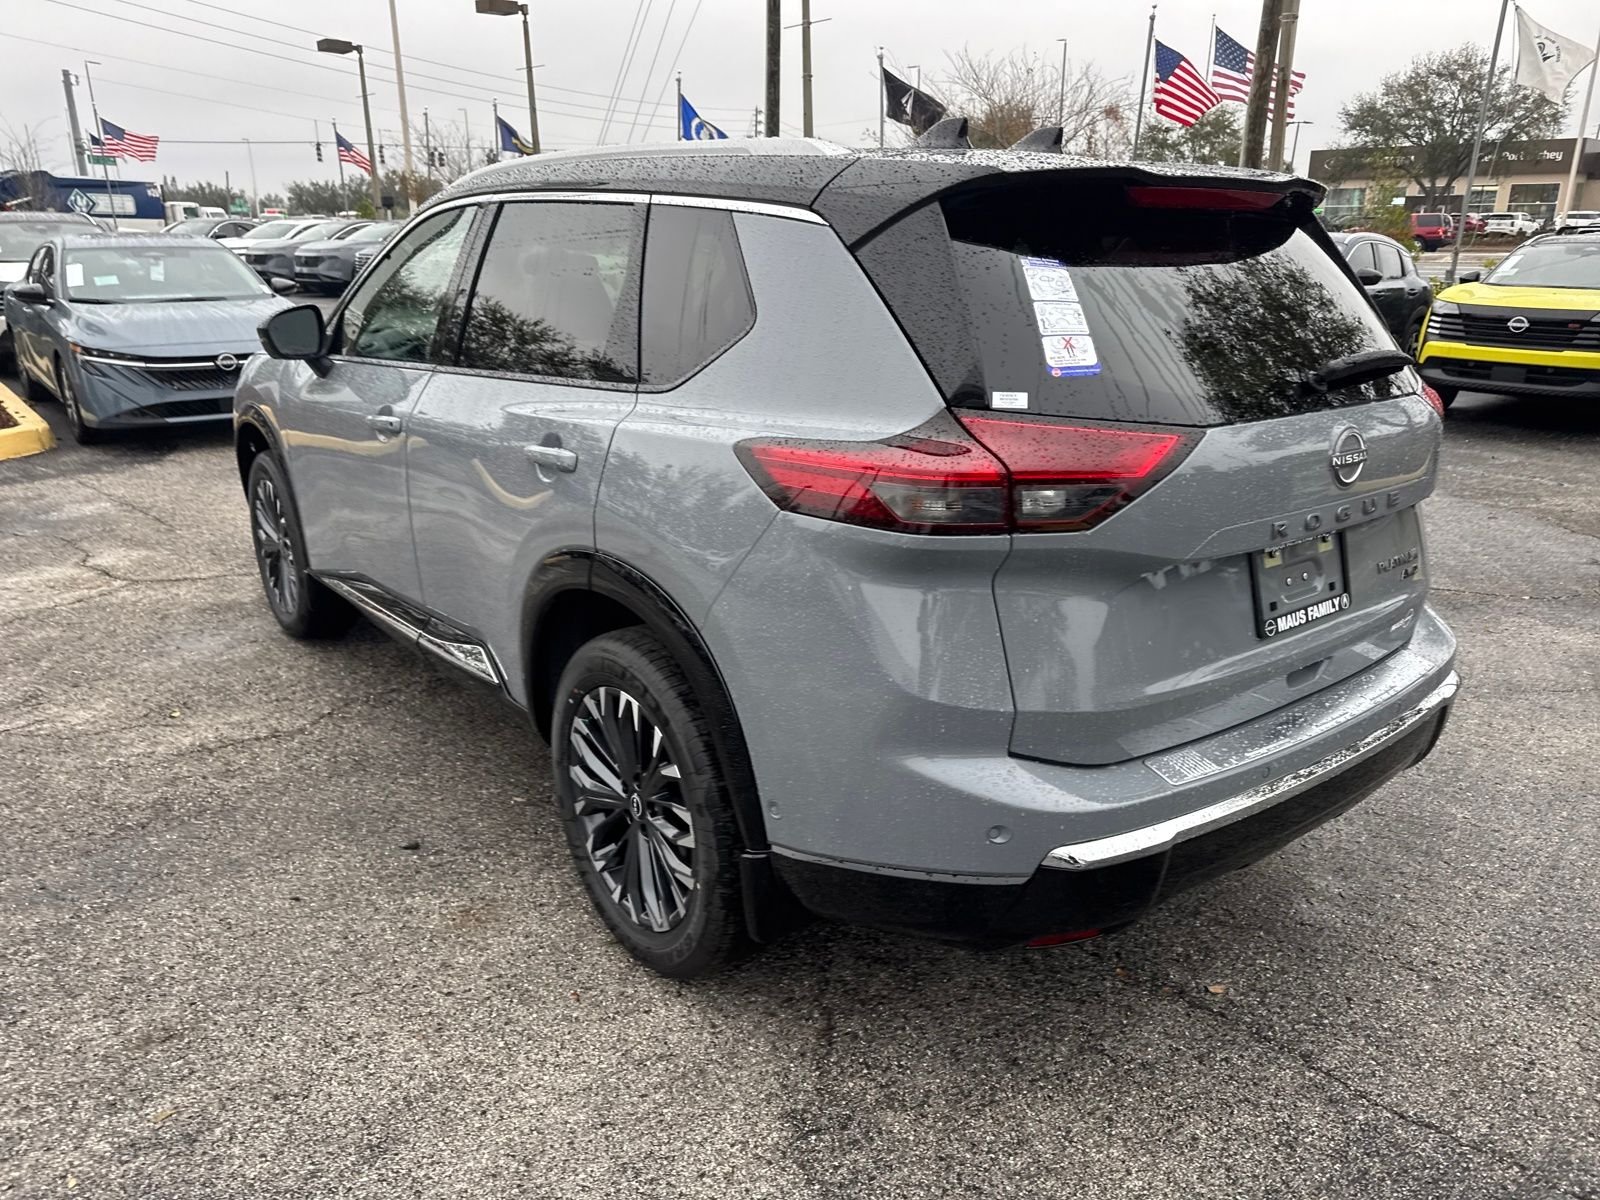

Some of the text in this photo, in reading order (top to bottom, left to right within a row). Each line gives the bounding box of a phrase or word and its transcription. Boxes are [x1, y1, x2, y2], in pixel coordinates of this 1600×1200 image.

[1271, 491, 1399, 540] ROGUE
[1277, 596, 1340, 632] MAUS FAMILY
